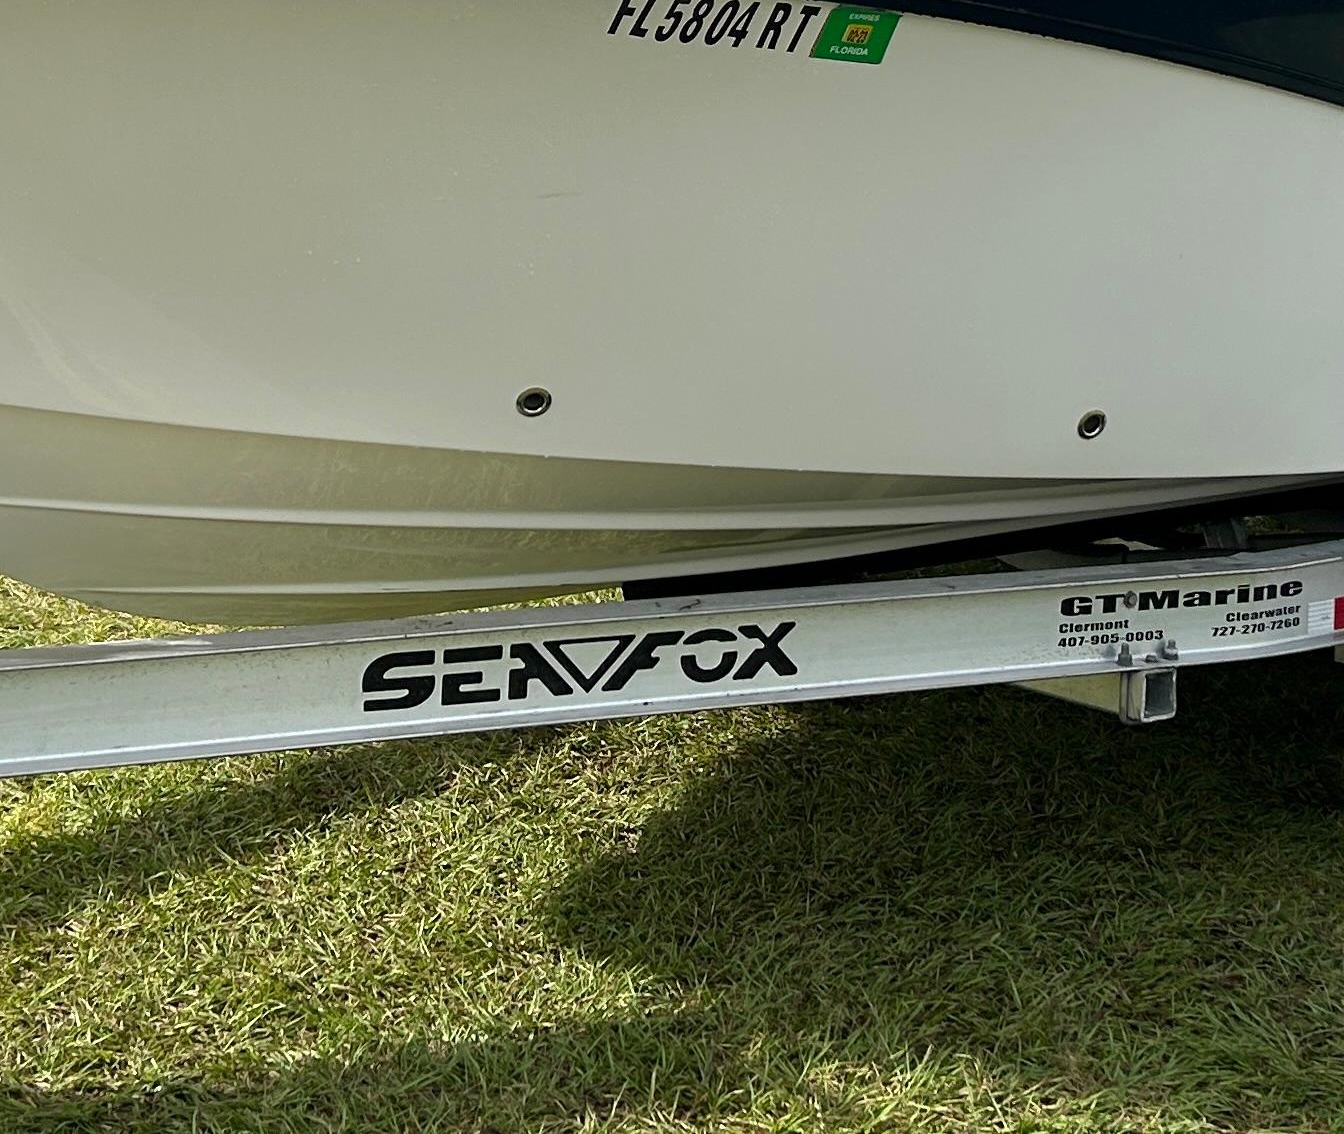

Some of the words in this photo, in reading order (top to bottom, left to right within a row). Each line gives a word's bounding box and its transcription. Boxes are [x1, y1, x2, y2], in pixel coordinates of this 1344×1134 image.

[829, 46, 869, 56] FLORIDA
[1137, 580, 1304, 612] Marine
[1226, 605, 1302, 623] Clearwater
[1058, 619, 1130, 634] Clermont
[1211, 616, 1301, 637] 727-270-7260
[1057, 630, 1164, 648] 407-905-0003
